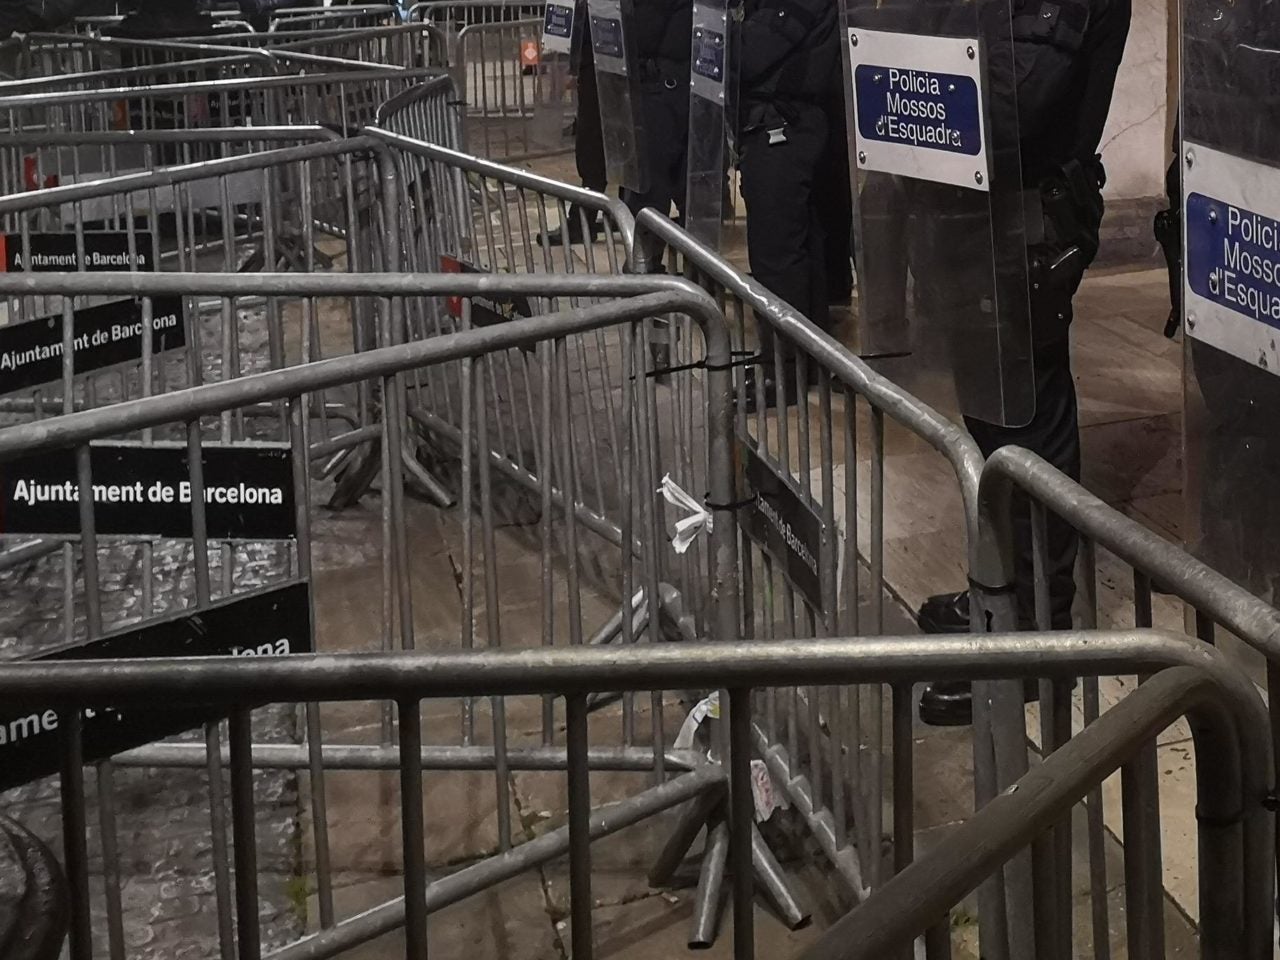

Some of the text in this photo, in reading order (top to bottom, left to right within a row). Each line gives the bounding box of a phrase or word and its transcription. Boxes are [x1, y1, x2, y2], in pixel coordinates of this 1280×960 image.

[889, 69, 940, 95] Policia
[887, 92, 946, 120] Mossos
[876, 115, 962, 146] d'Esquadra
[14, 252, 76, 267] Antament
[1, 314, 177, 371] Ajuntamnt de Barcona
[148, 481, 174, 503] de
[179, 481, 282, 504] Brcelona
